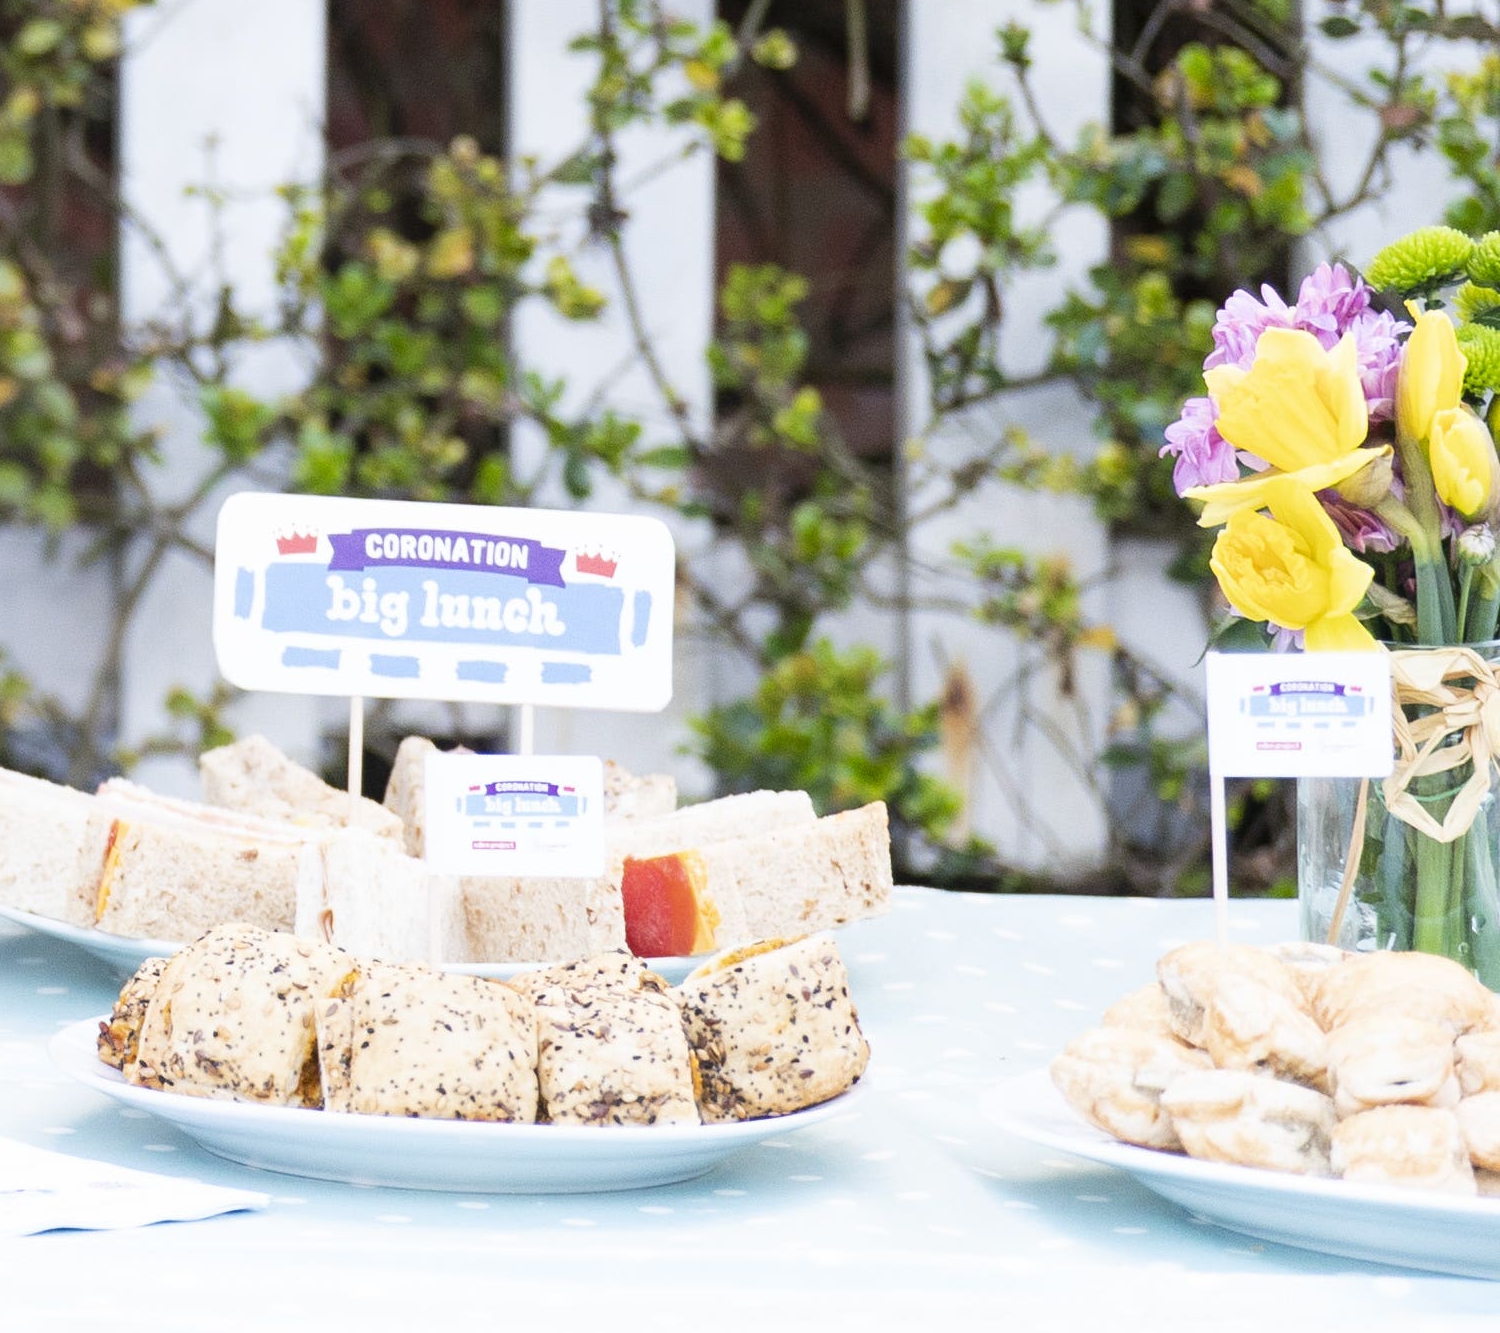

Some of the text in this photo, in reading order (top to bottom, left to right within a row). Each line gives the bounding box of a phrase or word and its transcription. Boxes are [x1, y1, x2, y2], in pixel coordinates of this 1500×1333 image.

[364, 533, 529, 570] CORONATION
[326, 576, 567, 637] big lunch
[495, 783, 549, 793] CORONATION
[484, 795, 562, 816] big lunch
